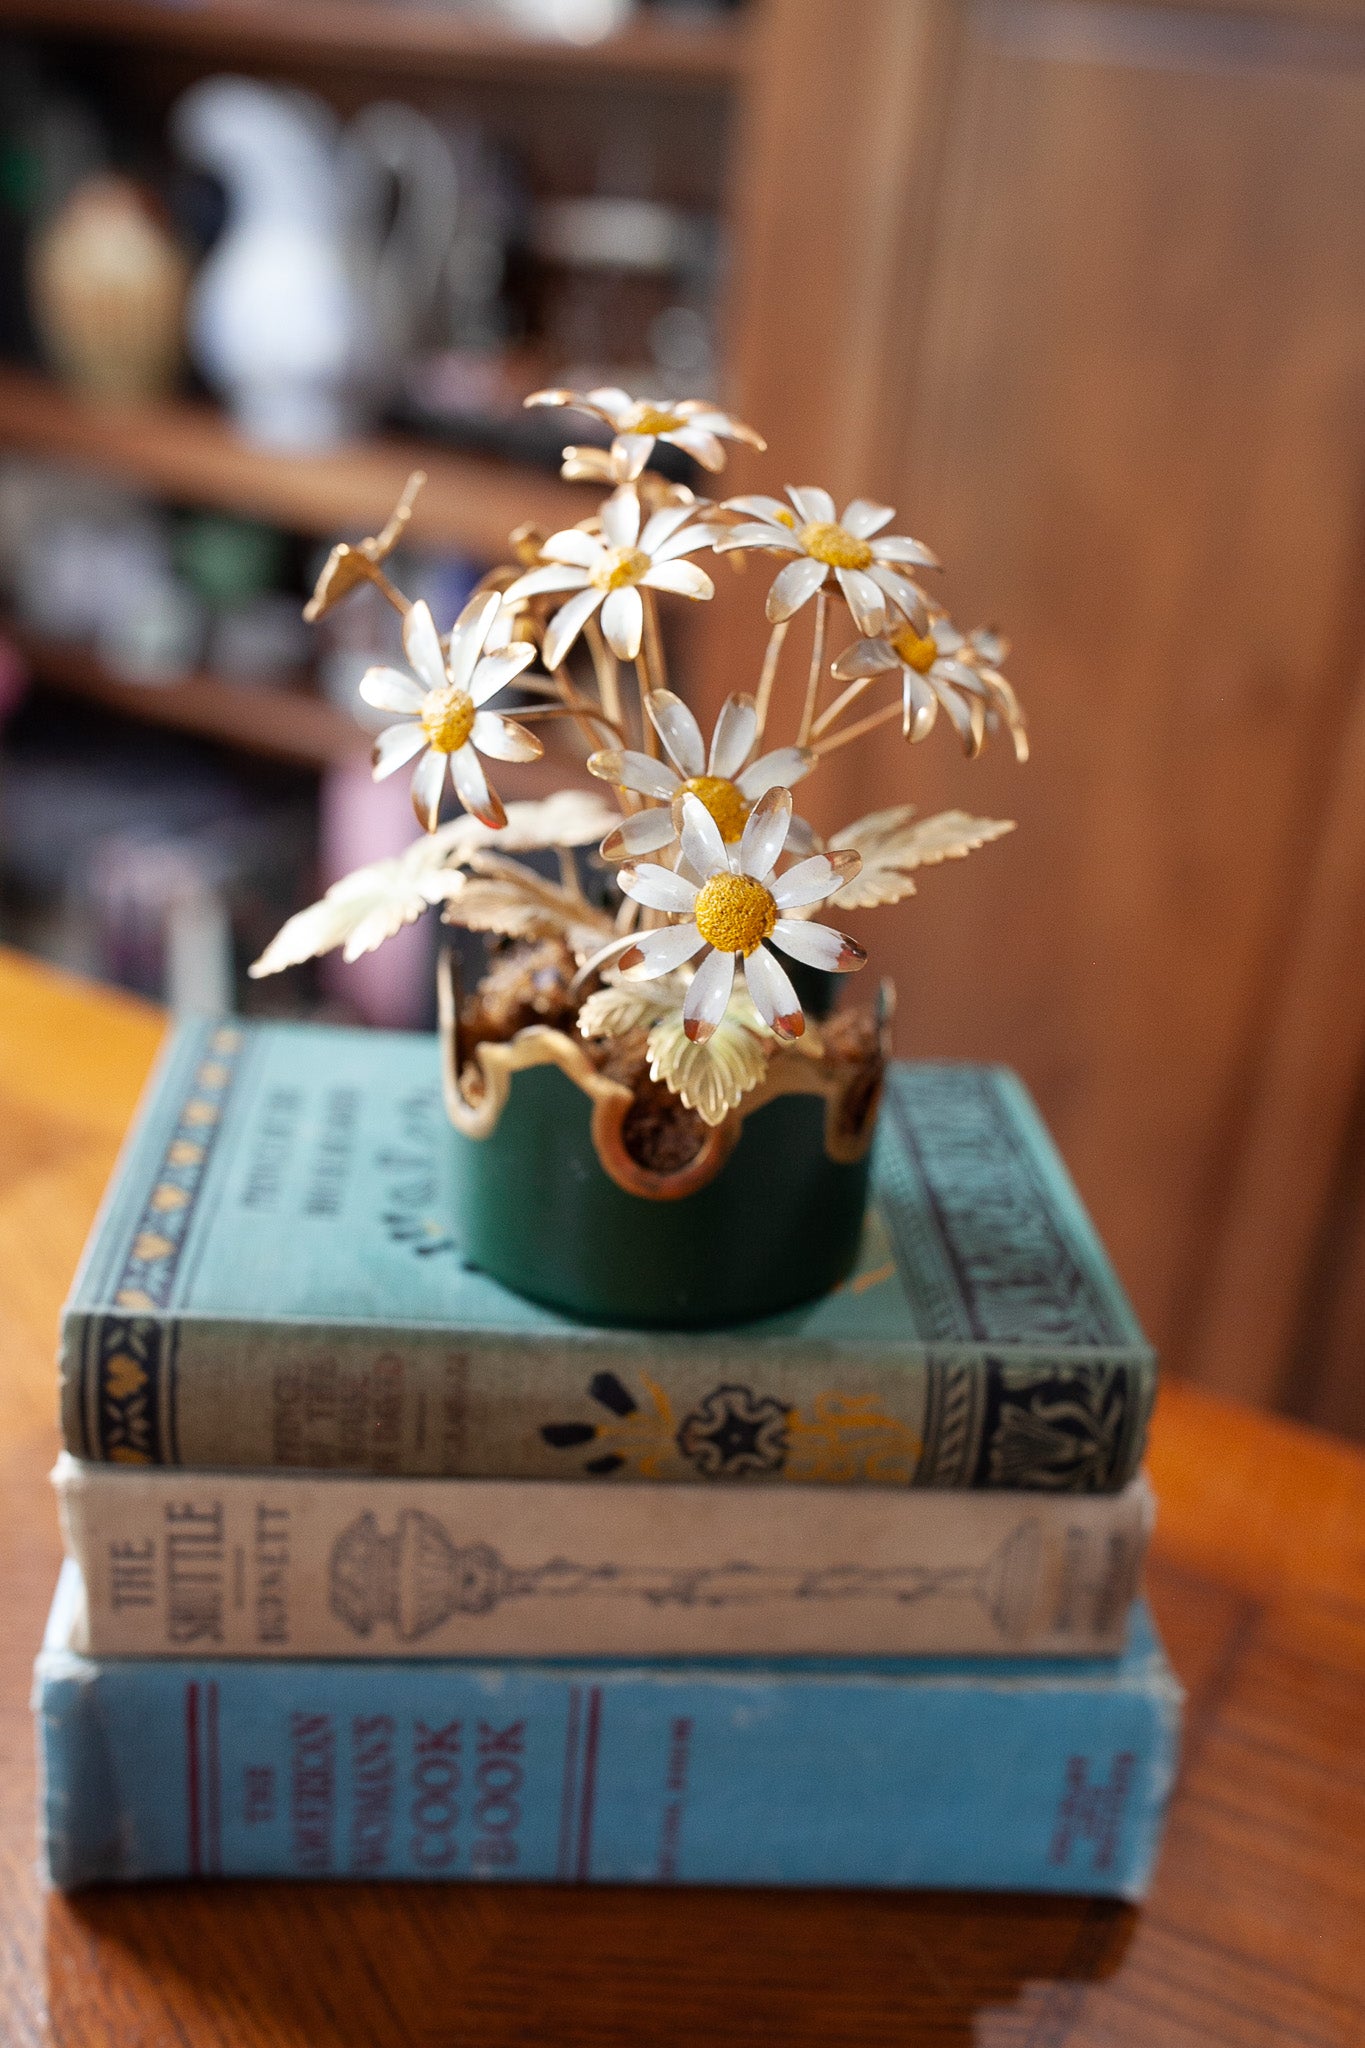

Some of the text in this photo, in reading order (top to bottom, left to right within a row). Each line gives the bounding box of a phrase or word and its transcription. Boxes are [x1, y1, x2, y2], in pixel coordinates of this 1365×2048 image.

[108, 1537, 154, 1613] THE
[409, 1718, 461, 1868] COOK
[468, 1718, 527, 1867] BOOK
